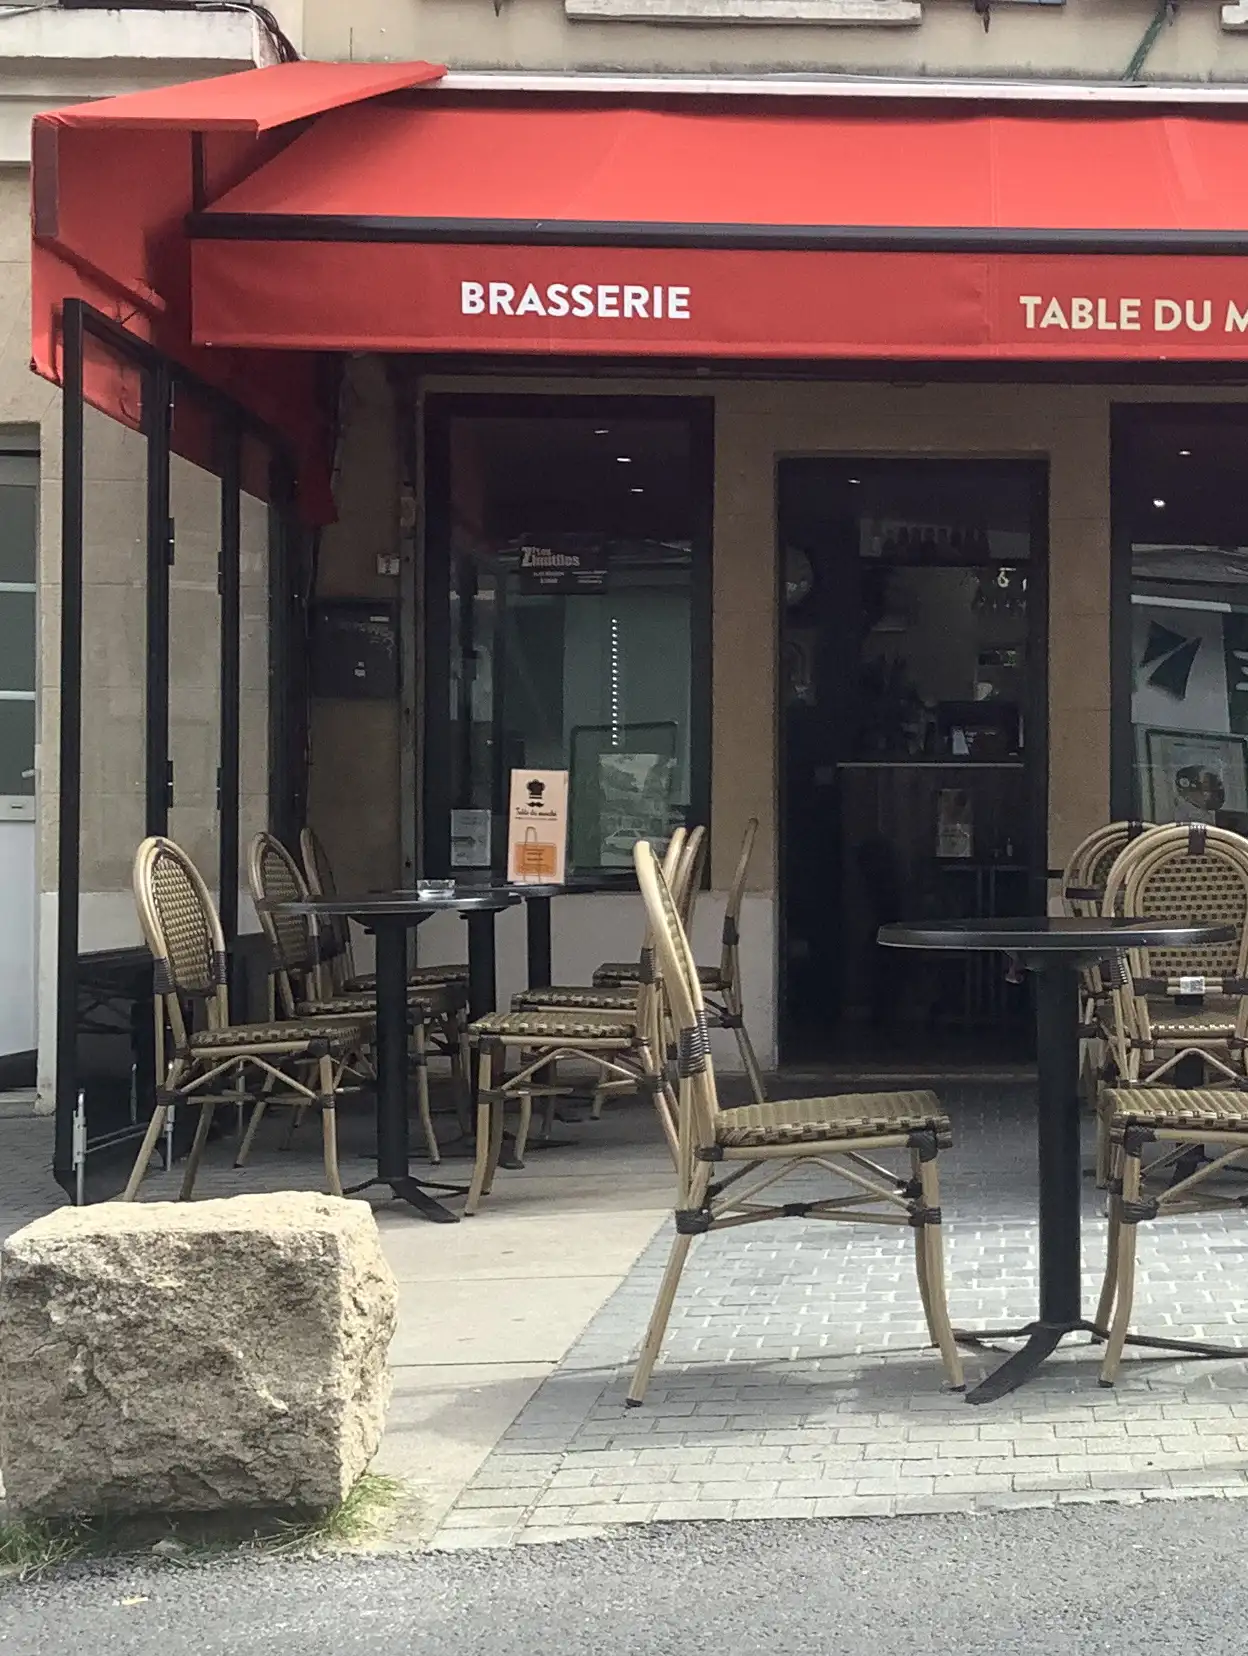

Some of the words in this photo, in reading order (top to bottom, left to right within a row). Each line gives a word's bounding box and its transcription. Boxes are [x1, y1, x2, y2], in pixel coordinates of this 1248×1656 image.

[459, 280, 692, 321] BRASSERIE
[1019, 295, 1142, 331] TABLE
[1153, 299, 1213, 333] DU
